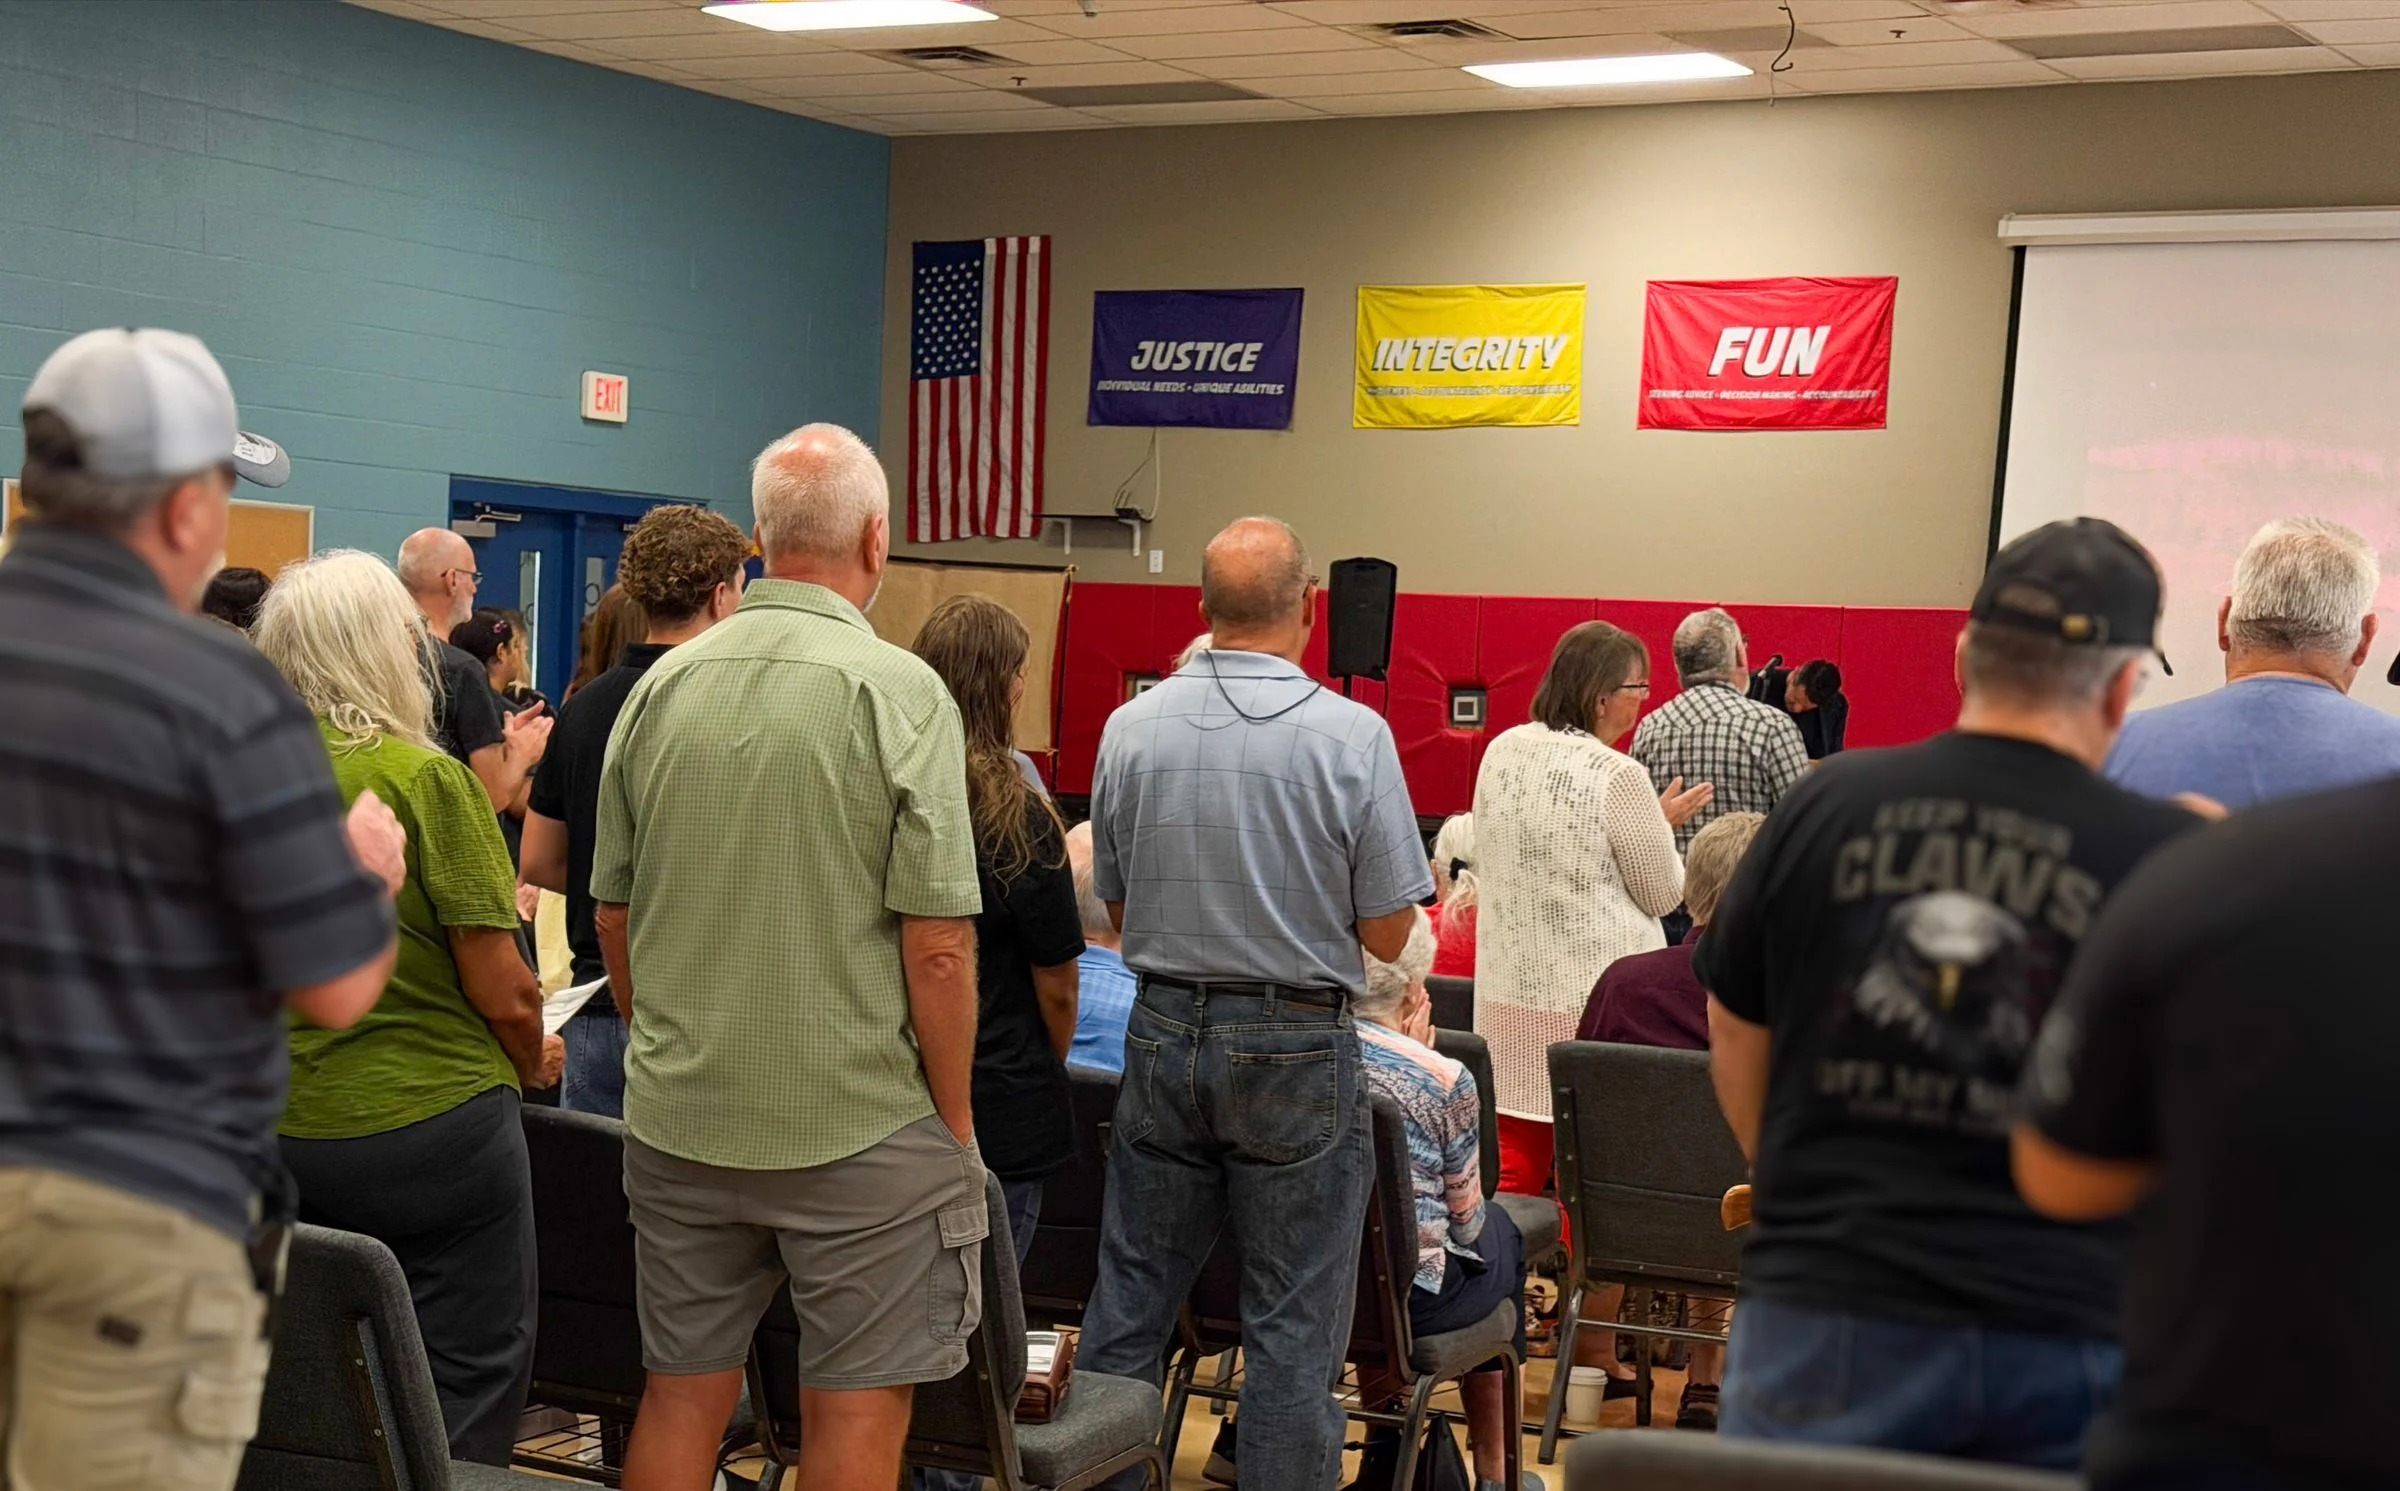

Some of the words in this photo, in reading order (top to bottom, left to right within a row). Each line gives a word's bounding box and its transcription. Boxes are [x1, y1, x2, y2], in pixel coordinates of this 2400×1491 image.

[1130, 341, 1264, 373] JUSTICE
[1371, 334, 1568, 372] INTEGRITY
[1707, 325, 1832, 378] FUN
[595, 378, 624, 416] EXIT
[1152, 381, 1187, 393] NEEDS
[1192, 382, 1234, 394] UNIQUE
[1232, 382, 1285, 395] ABILITIES
[1832, 832, 2102, 939] CLAWS
